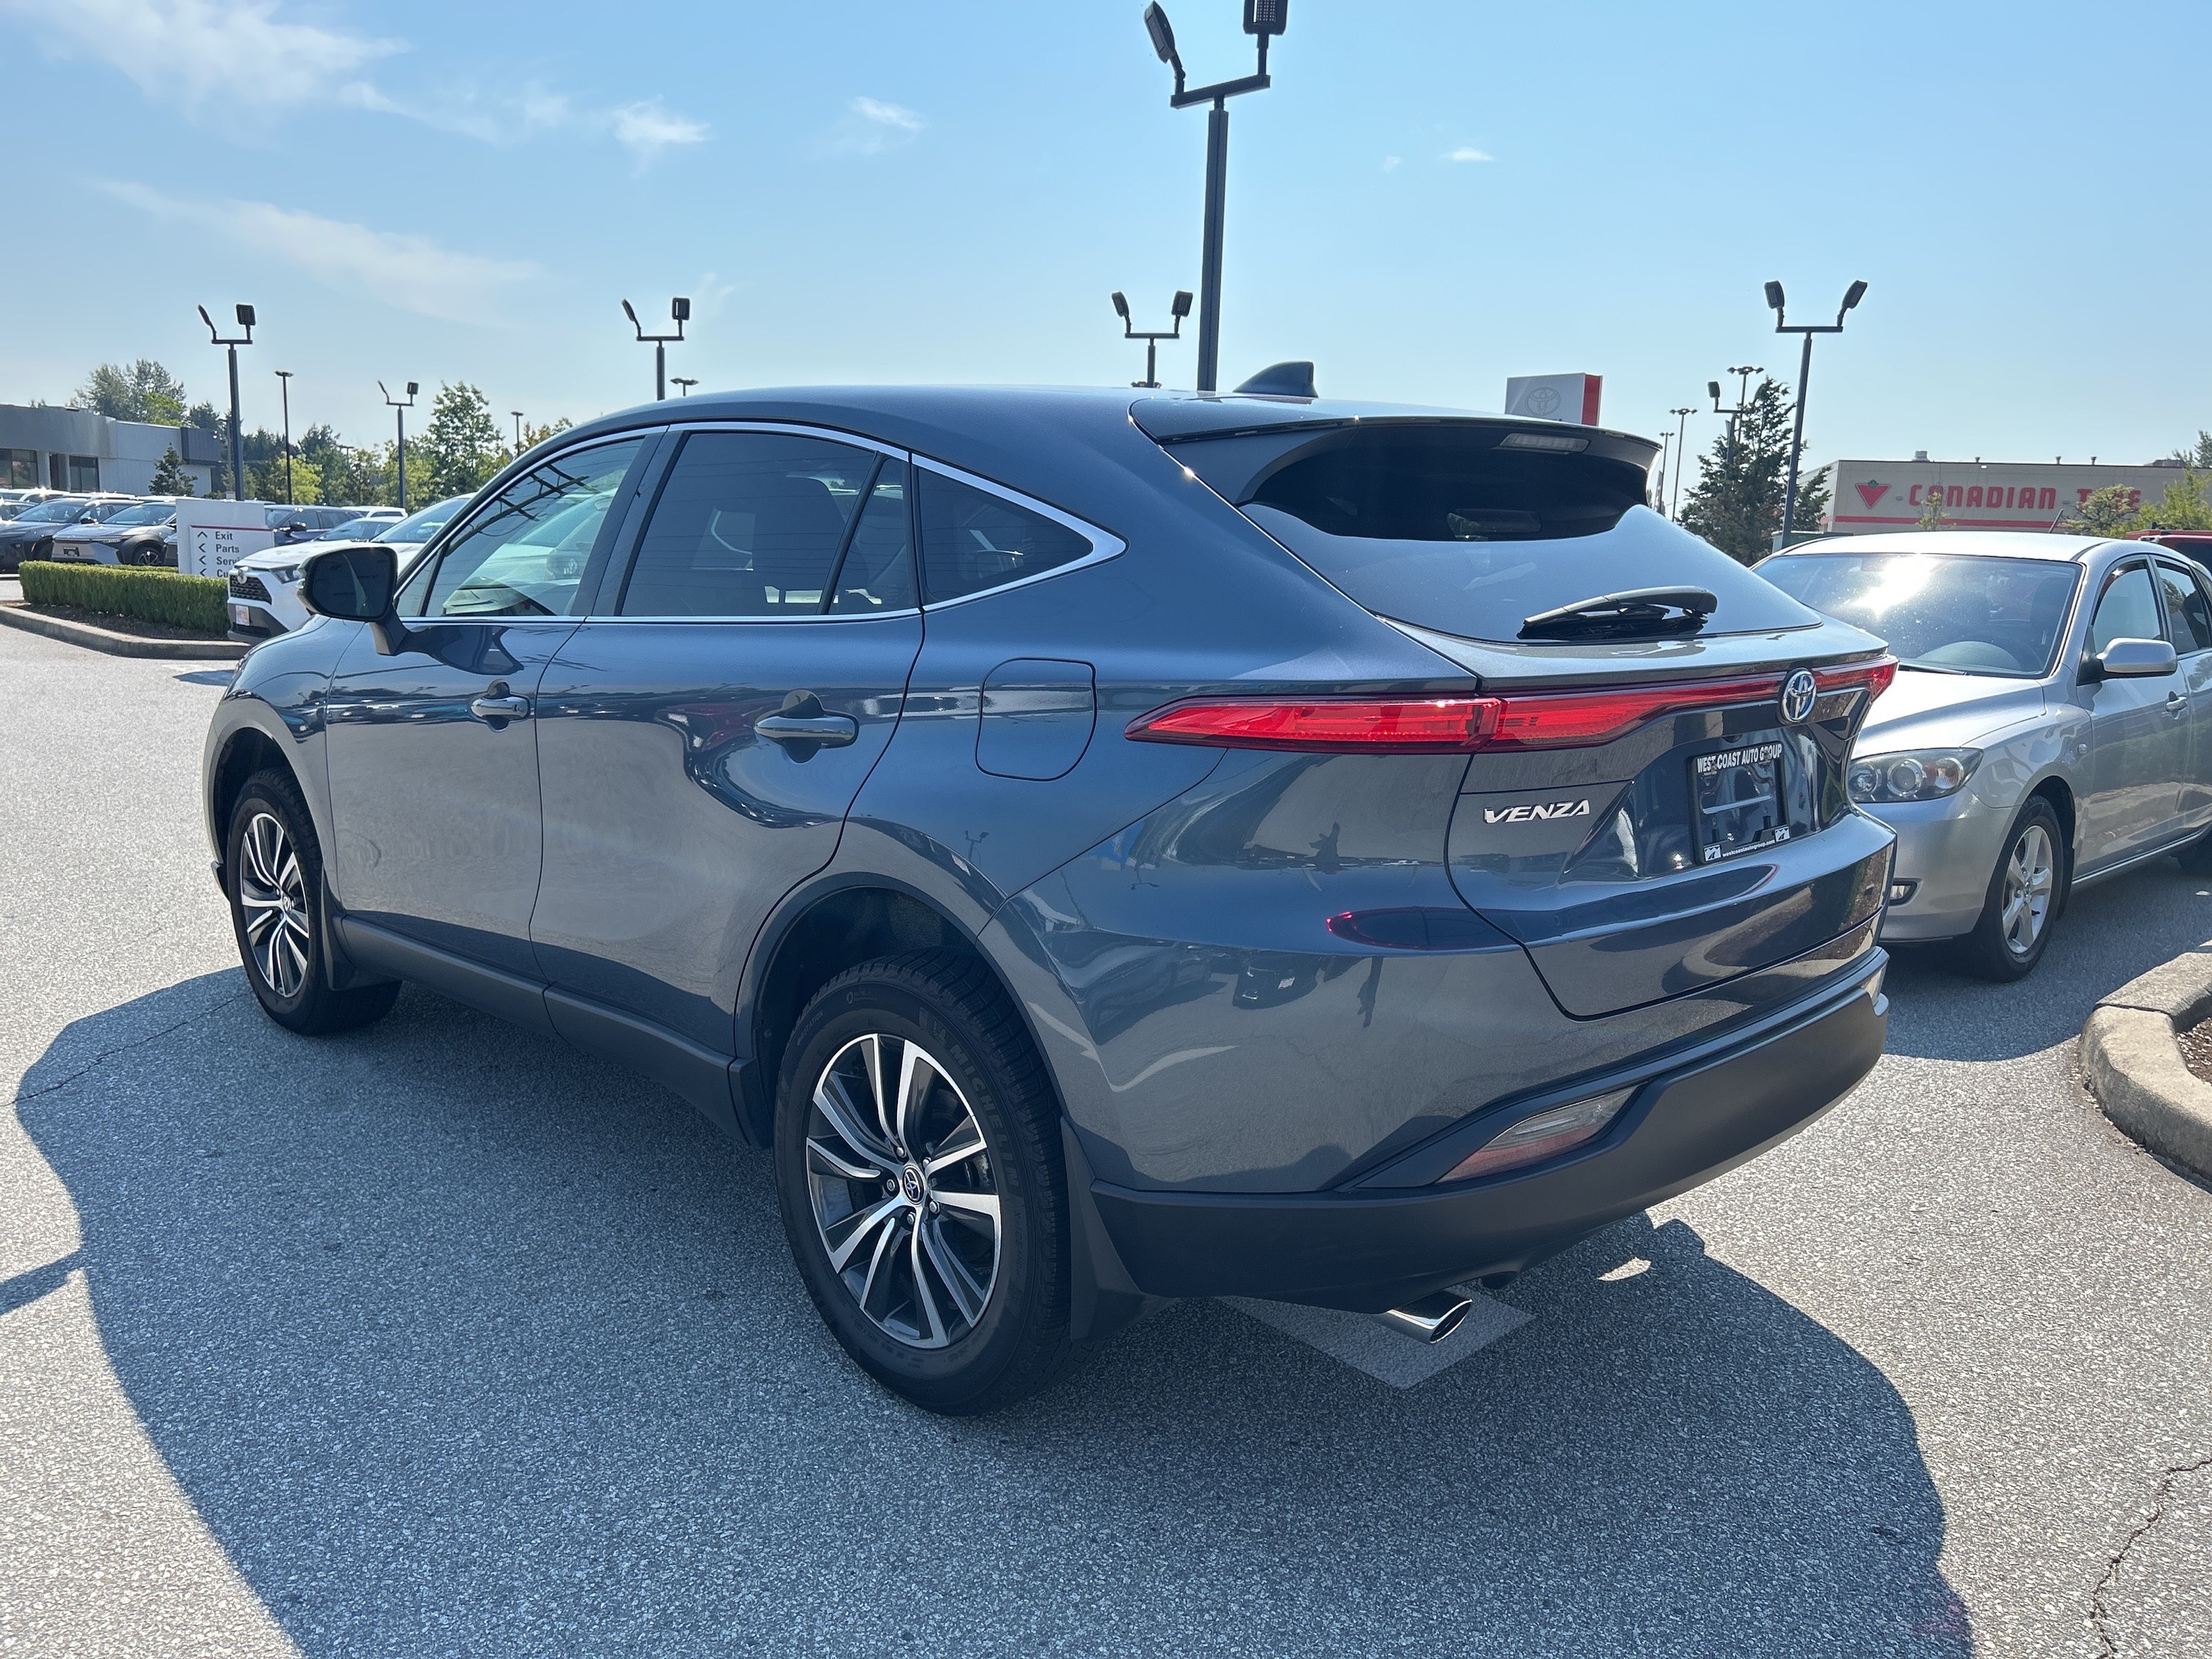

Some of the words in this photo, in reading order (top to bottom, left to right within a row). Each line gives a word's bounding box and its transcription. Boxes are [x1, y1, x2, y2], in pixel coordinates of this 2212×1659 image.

[1909, 485, 2056, 509] CANADIAN
[2077, 488, 2141, 512] TE
[215, 531, 233, 540] Exit
[216, 544, 240, 553] Parts
[1717, 751, 1740, 770] COAST
[1741, 747, 1758, 765] AUTO
[1484, 800, 1590, 823] VENZA
[949, 1044, 1020, 1187] MICHELIN
